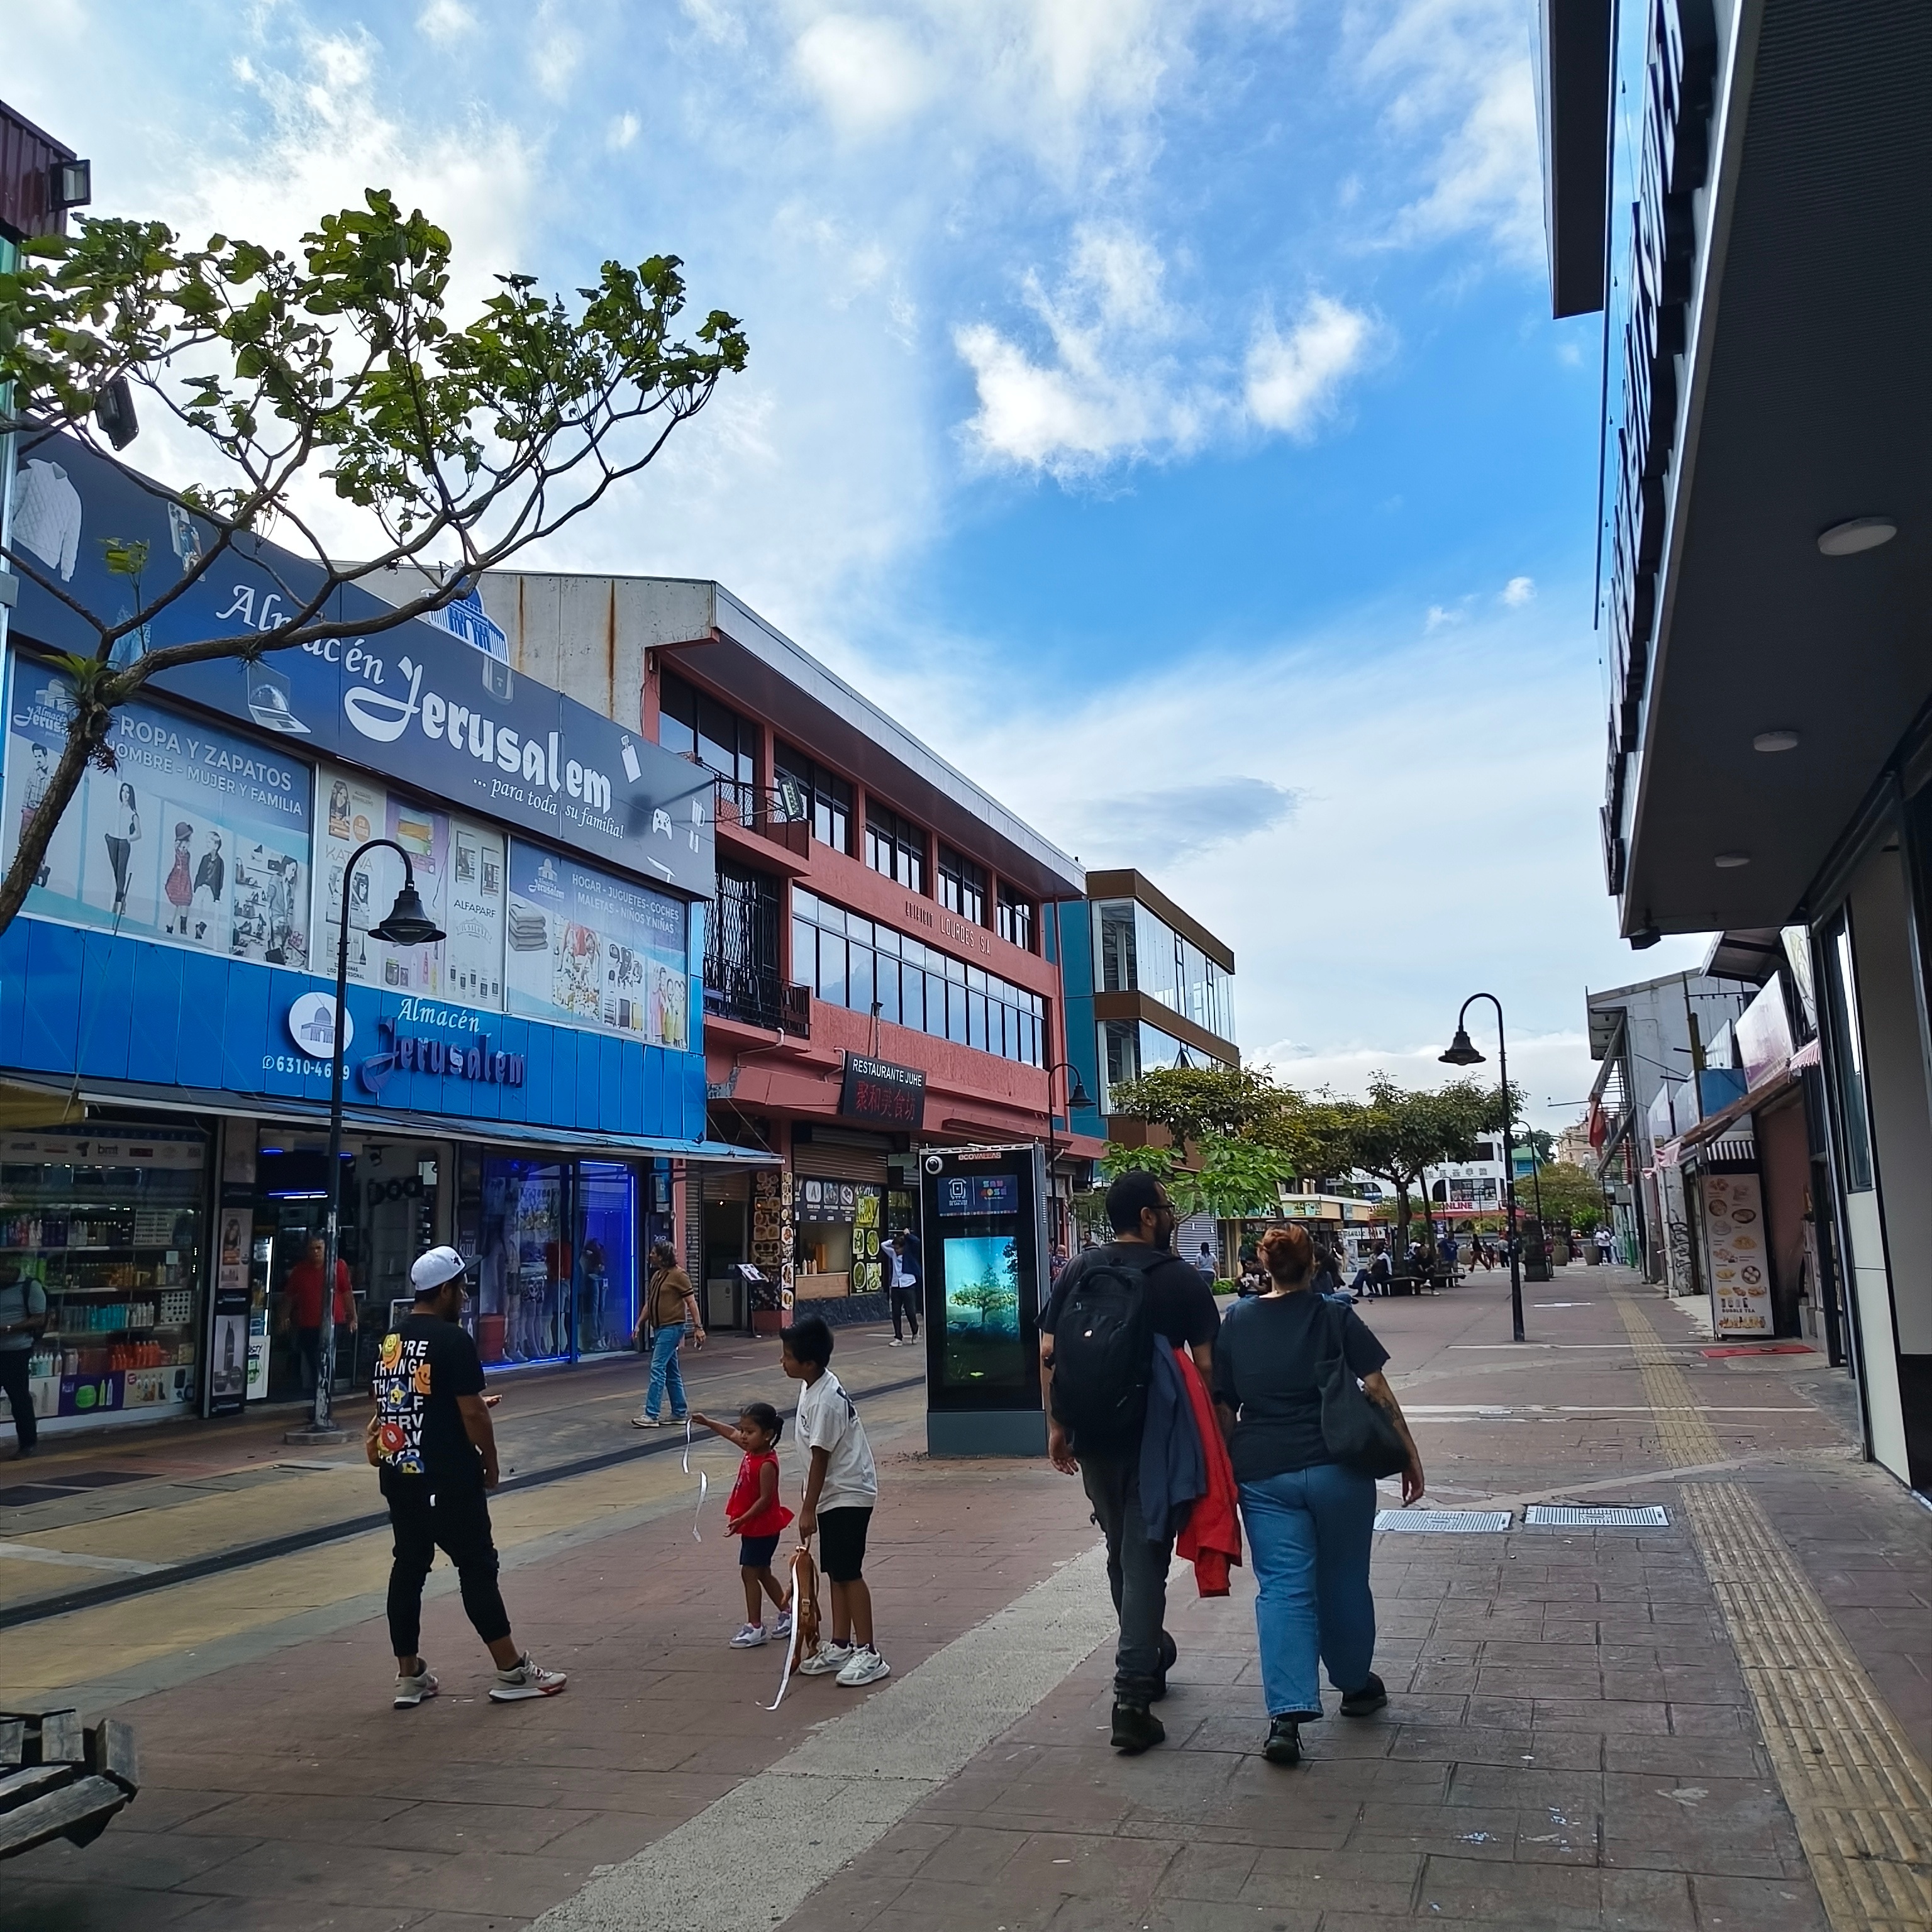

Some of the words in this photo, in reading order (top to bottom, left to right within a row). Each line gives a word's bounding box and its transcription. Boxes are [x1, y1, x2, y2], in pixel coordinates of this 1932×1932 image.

[120, 715, 181, 754] ROPA
[186, 738, 199, 760] Y
[204, 745, 292, 791] ZAPATOS
[344, 655, 611, 814] Jerusalem
[187, 765, 236, 794] MUJER
[239, 782, 248, 797] Y
[251, 787, 303, 816] FAMILIA
[490, 779, 525, 802] para
[527, 791, 558, 816] toda
[565, 804, 578, 820] su
[577, 807, 625, 839] familia!
[326, 844, 374, 872] KATVA
[453, 899, 497, 918] ALFAPARF
[572, 874, 601, 893] HOGAR
[650, 902, 680, 921] COCHES
[577, 892, 614, 914] MALETAS
[621, 906, 645, 924] NIÑOS
[645, 914, 651, 926] Y
[652, 916, 675, 934] NIÑAS
[905, 901, 934, 928] EDIFICIO
[940, 914, 974, 948] LOURDES
[397, 997, 481, 1033] Almacén
[276, 1055, 351, 1080] 6310-469
[361, 1014, 527, 1092] Jerusalem
[853, 1058, 904, 1082] RESTAURANTE
[905, 1072, 923, 1087] JUHE
[1441, 1201, 1474, 1209] NLINE
